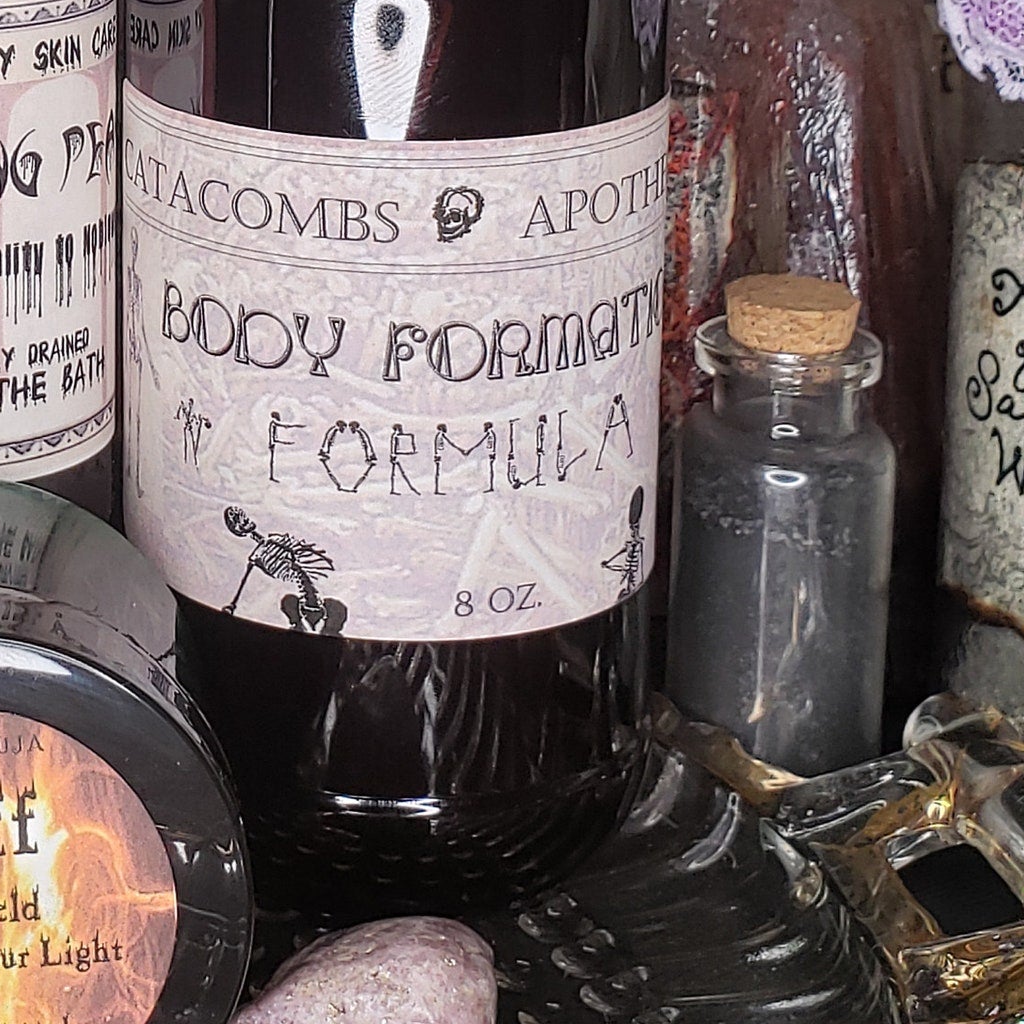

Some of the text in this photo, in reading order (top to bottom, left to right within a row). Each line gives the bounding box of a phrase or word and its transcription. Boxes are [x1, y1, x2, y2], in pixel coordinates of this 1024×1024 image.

[33, 33, 82, 74] SKIN
[124, 137, 401, 245] CATACOMBS
[27, 326, 90, 367] DRAINED
[161, 277, 346, 377] BODY
[62, 345, 106, 400] BATH
[454, 582, 543, 617] 8 OZ.
[40, 929, 125, 974] Light
